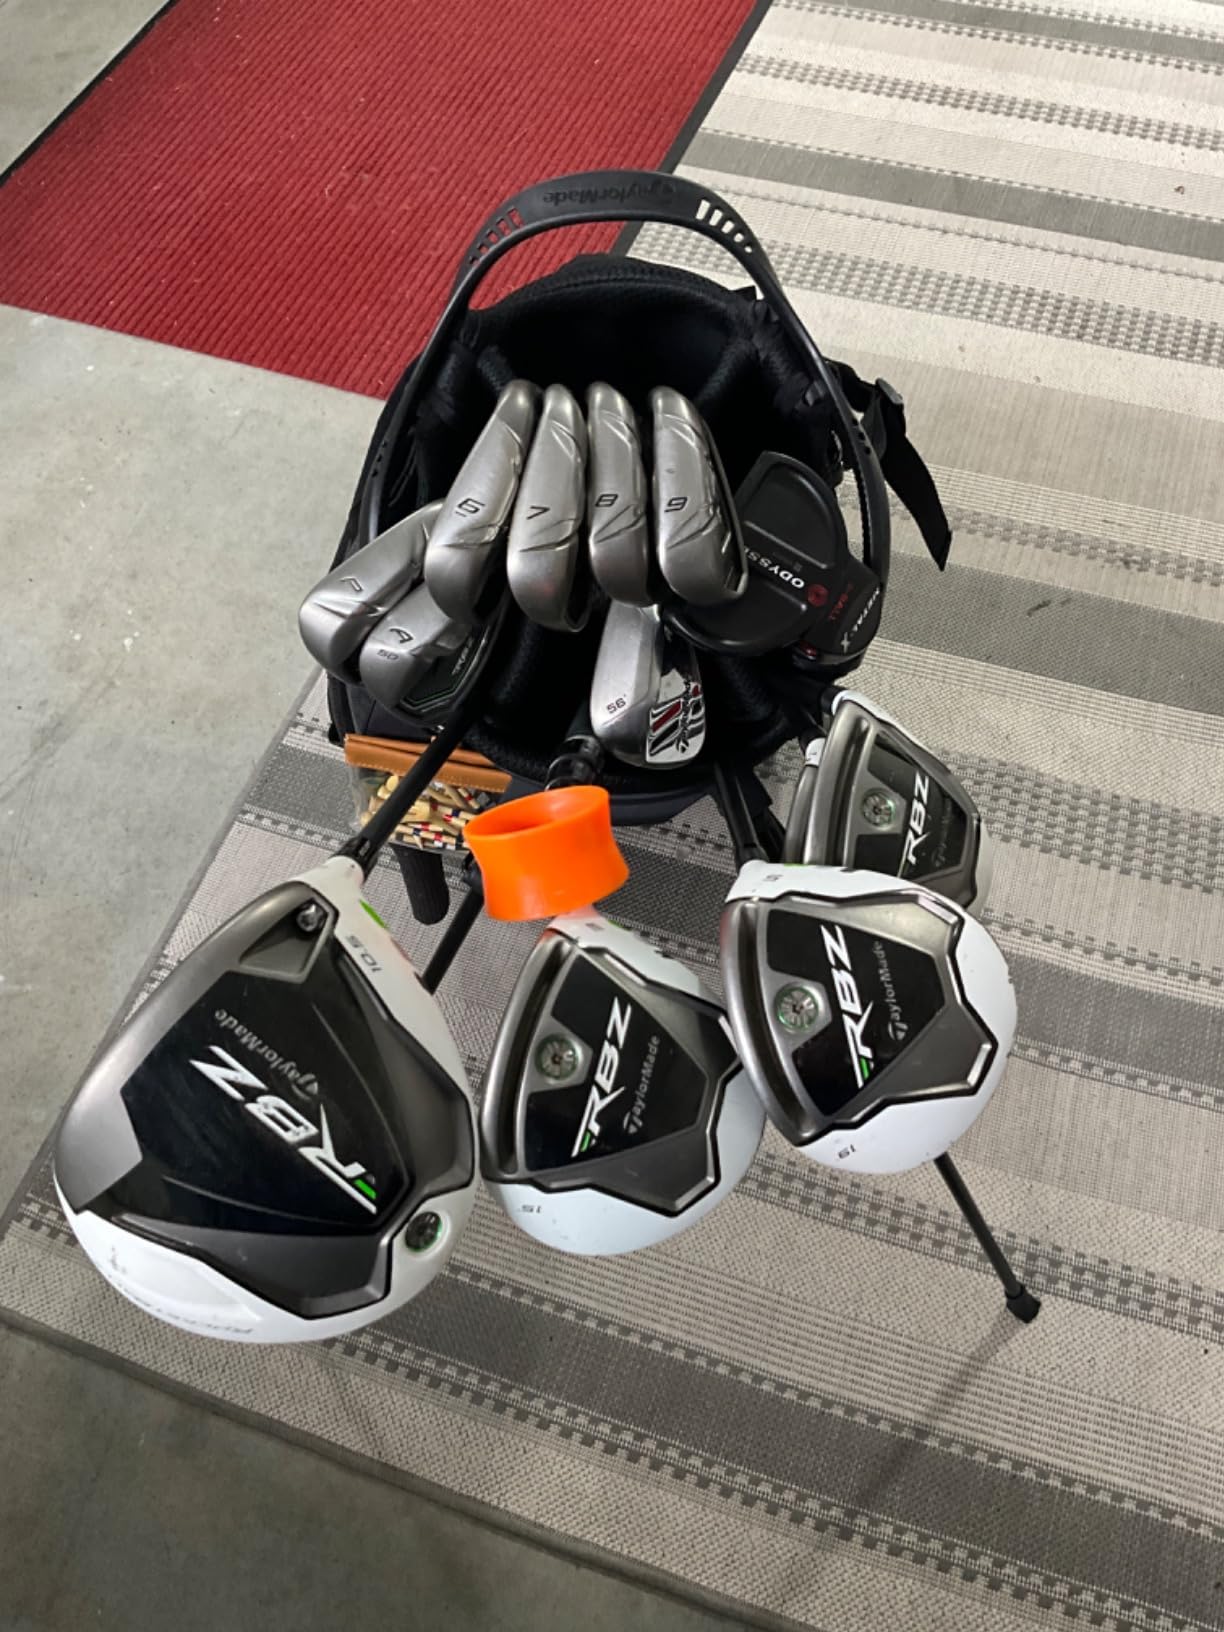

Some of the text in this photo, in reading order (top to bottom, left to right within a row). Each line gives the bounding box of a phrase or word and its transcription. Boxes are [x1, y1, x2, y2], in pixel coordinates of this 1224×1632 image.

[594, 493, 619, 507] 8
[663, 495, 688, 512] 9
[348, 934, 382, 974] 10.5
[875, 941, 909, 1041] TaylorMade
[212, 1008, 320, 1100] TaylorMade
[820, 925, 875, 1089] RBZ
[571, 996, 632, 1157] RBZ
[622, 1035, 661, 1135] TaylorMade
[188, 1045, 378, 1215] RBZ
